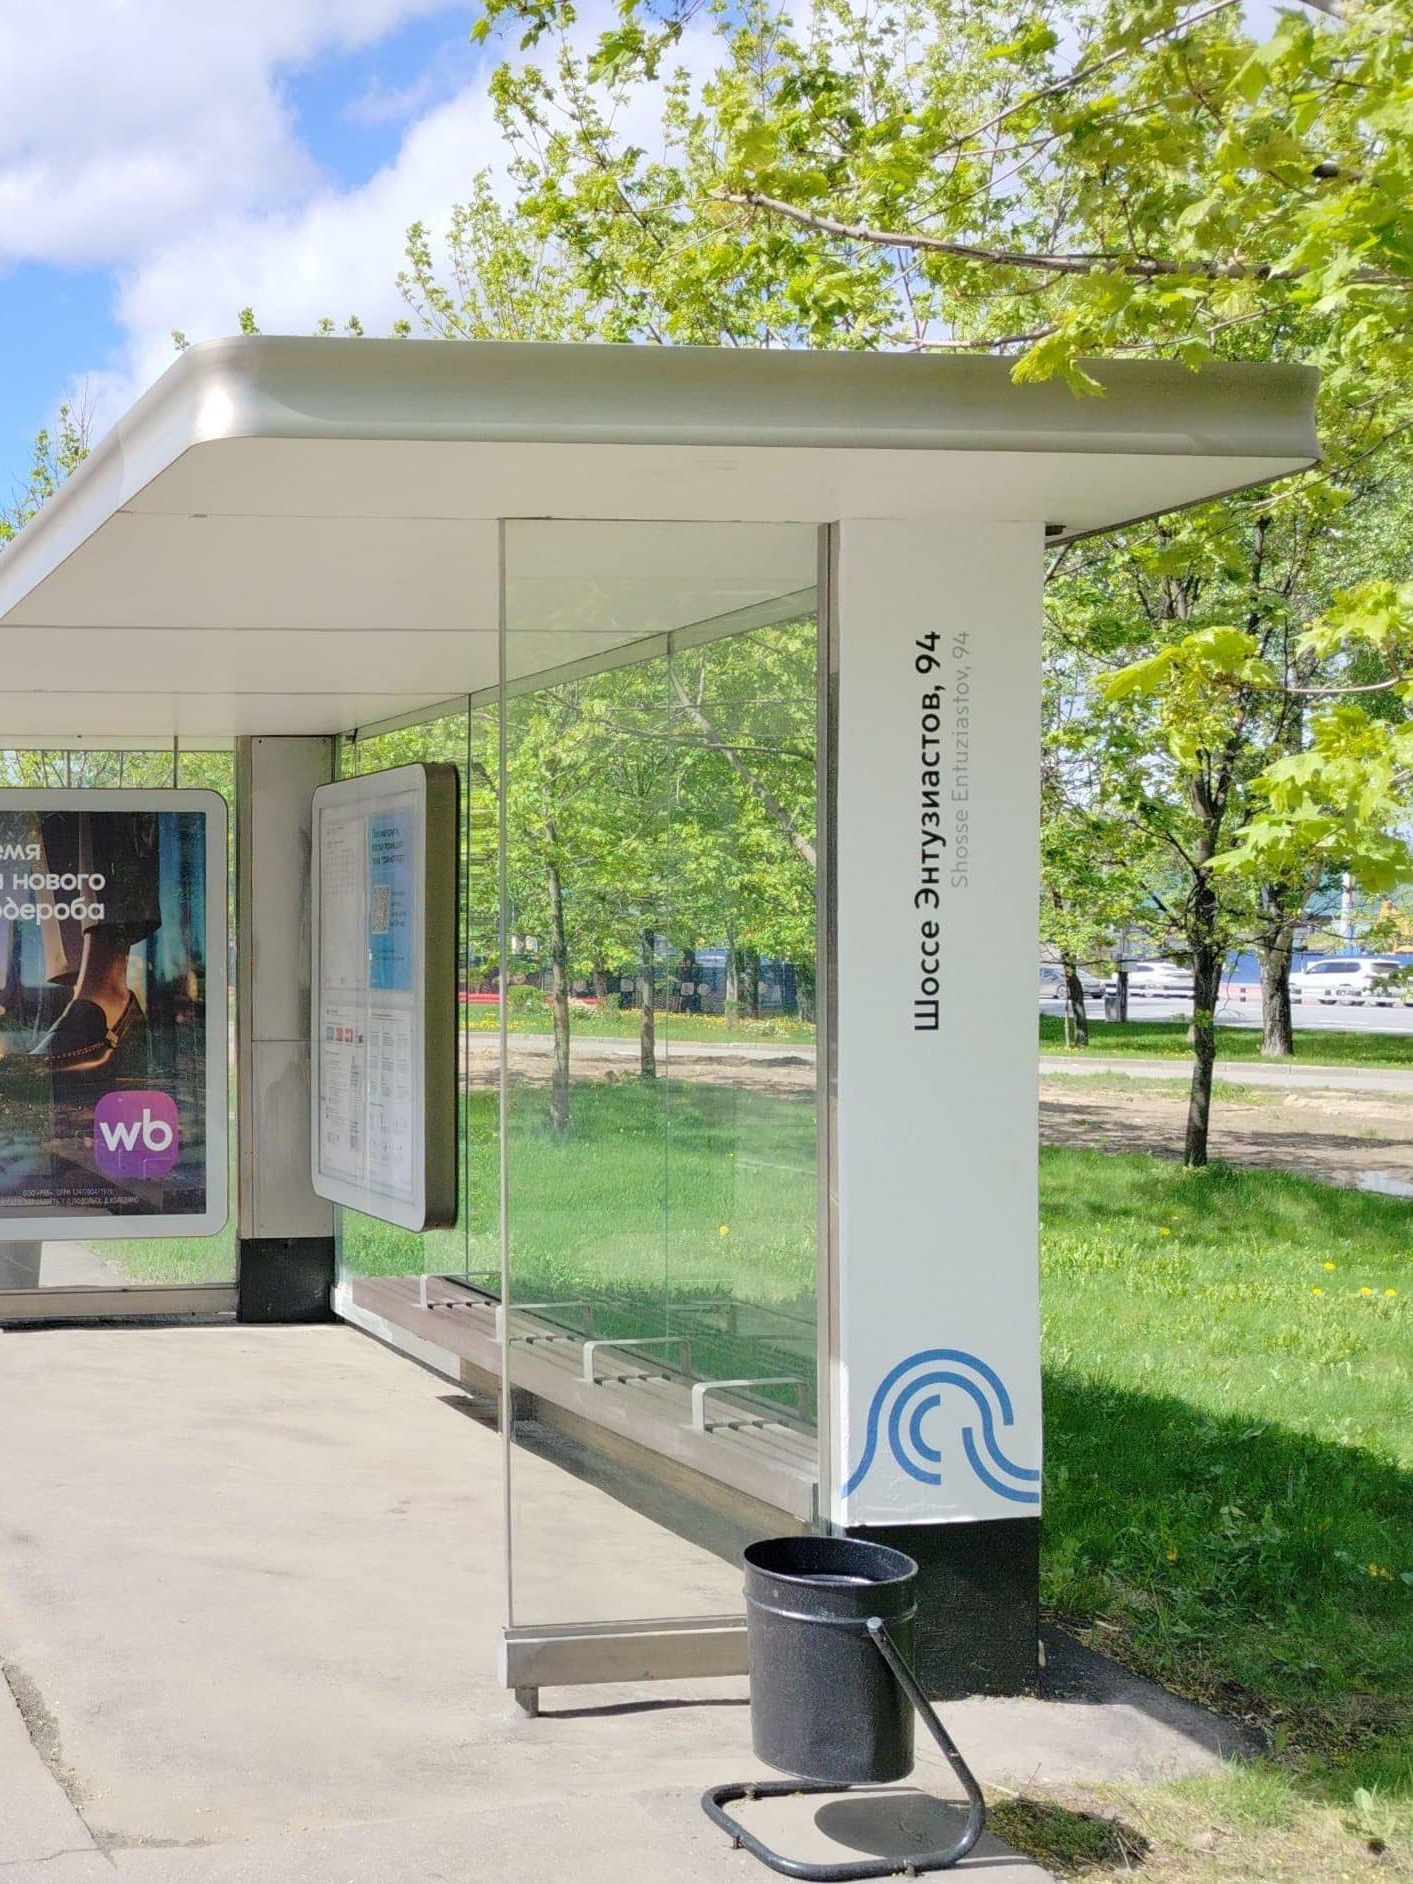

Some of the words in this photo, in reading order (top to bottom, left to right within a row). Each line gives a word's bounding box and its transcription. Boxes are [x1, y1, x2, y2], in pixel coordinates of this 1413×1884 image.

[914, 630, 942, 674] 94
[951, 631, 971, 660] 94
[950, 665, 973, 802] Entuziastov,
[914, 684, 947, 909] Энтузиастов,
[950, 809, 969, 889] Shosse
[12, 873, 106, 891] нового
[914, 919, 940, 1031] Шоссе
[99, 1108, 173, 1152] wb
